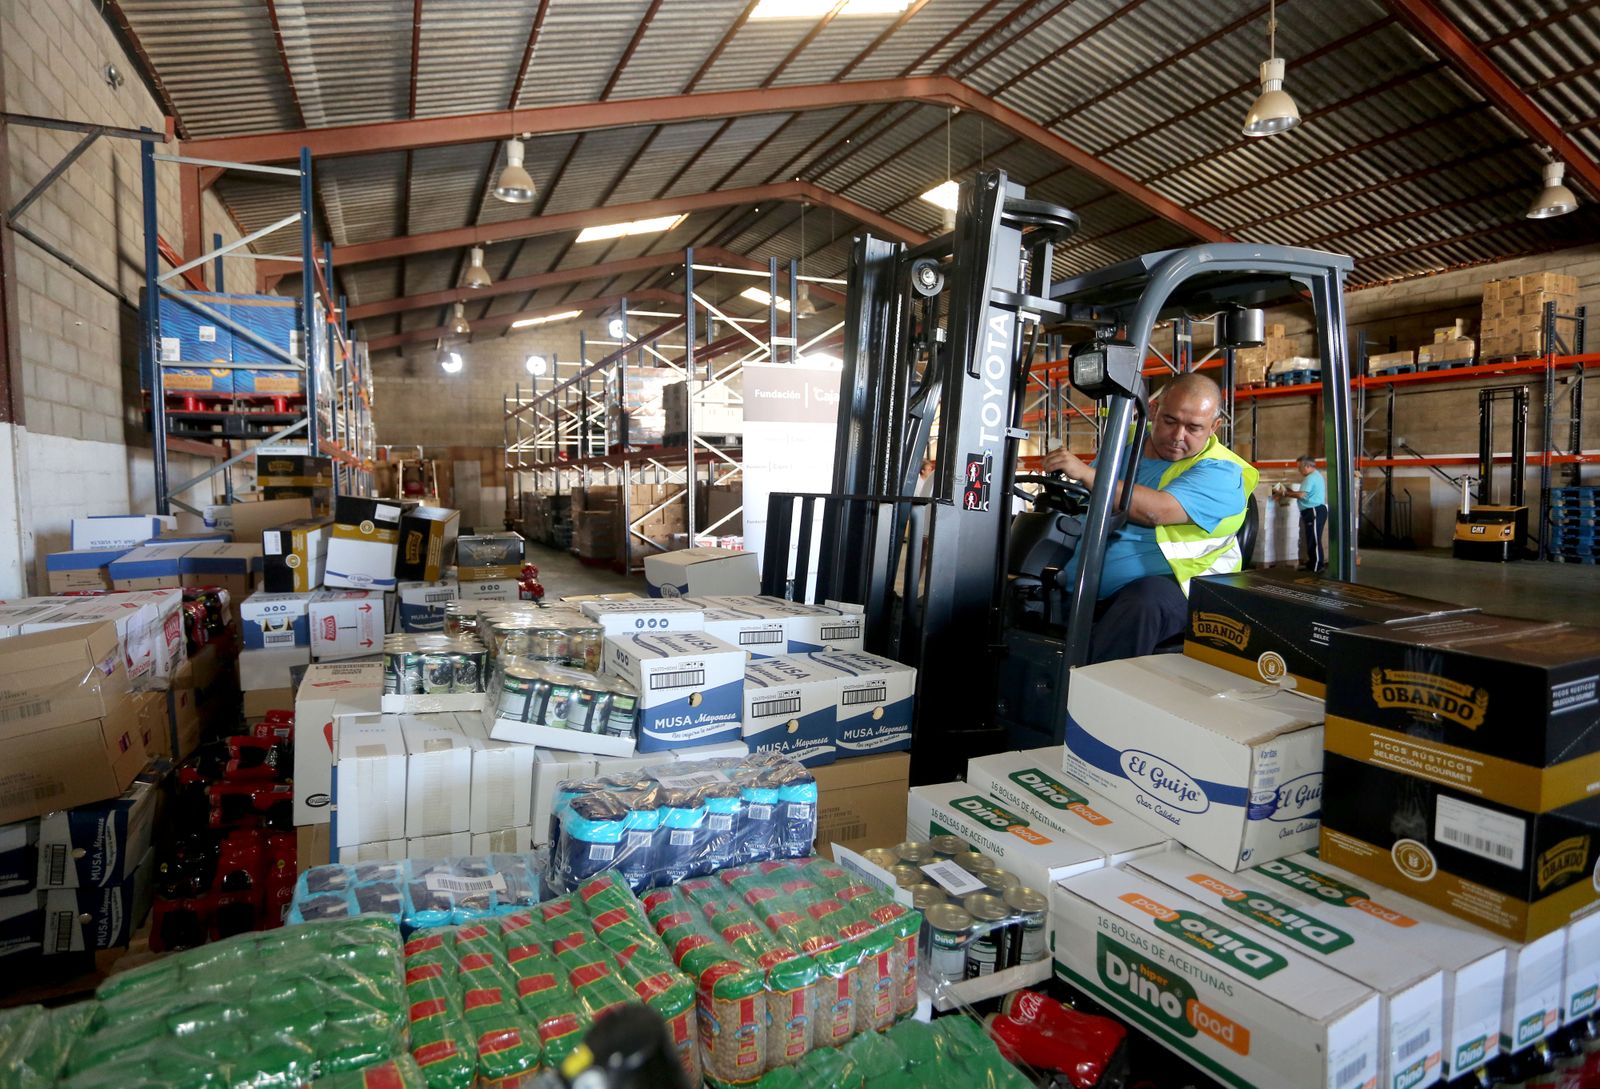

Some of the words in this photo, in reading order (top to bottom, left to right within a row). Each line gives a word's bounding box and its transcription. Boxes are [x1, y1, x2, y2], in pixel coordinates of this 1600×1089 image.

[979, 313, 1009, 447] TOYOTA
[754, 388, 801, 400] Fundación
[813, 387, 840, 406] Caja
[1471, 526, 1485, 534] CAT
[675, 633, 718, 651] MUSA
[1198, 622, 1244, 645] OBANDO
[764, 660, 811, 680] MUSA
[847, 653, 893, 670] MUSA
[1382, 686, 1475, 721] OBANDO
[654, 715, 692, 730] MUSA
[694, 712, 737, 725] Mayonesa
[843, 728, 874, 740] MUSA
[875, 723, 909, 736] Mayonesa
[756, 741, 790, 753] MUSA
[791, 736, 830, 750] Mayonesa
[1373, 739, 1408, 755] PICOS
[1411, 748, 1473, 774] RÚSTICOS
[1129, 755, 1147, 777] El
[1150, 766, 1199, 803] Guijo
[1424, 764, 1473, 783] GOURMET
[991, 780, 999, 791] 16
[999, 784, 1020, 808] BOLSAS
[1020, 798, 1029, 812] DE
[1017, 773, 1069, 804] Dino
[1277, 788, 1293, 809] El
[1295, 783, 1322, 810] Gui
[958, 799, 1010, 828] Dino
[1071, 802, 1101, 821] food
[1135, 794, 1154, 810] Gran
[1154, 804, 1181, 827] Calidad
[931, 807, 939, 818] 16
[938, 808, 960, 831] BOLSAS
[959, 821, 969, 836] DE
[968, 826, 1005, 857] ACEITUNAS
[1010, 824, 1041, 842] food
[91, 852, 103, 881] MUSA
[1542, 850, 1583, 881] OBANDO
[1197, 877, 1245, 899] food
[1259, 860, 1346, 899] Dino
[1130, 897, 1176, 921] food
[1352, 899, 1402, 922] food
[97, 917, 108, 946] MUSA
[1247, 898, 1341, 946] Dino
[934, 934, 954, 944] Dino
[1180, 918, 1274, 969] Dino
[1097, 915, 1109, 930] 16
[1111, 919, 1149, 951] BOLSAS
[1151, 943, 1166, 960] DE
[1168, 955, 1235, 998] ACEITUNAS
[1105, 949, 1183, 1019] Dino
[1139, 963, 1169, 986] hiper
[1573, 991, 1595, 1012] Dino
[1191, 1003, 1235, 1043] food
[1519, 1020, 1543, 1041] Dino
[1458, 1043, 1485, 1066] Dino
[1396, 1064, 1424, 1089] Dino
